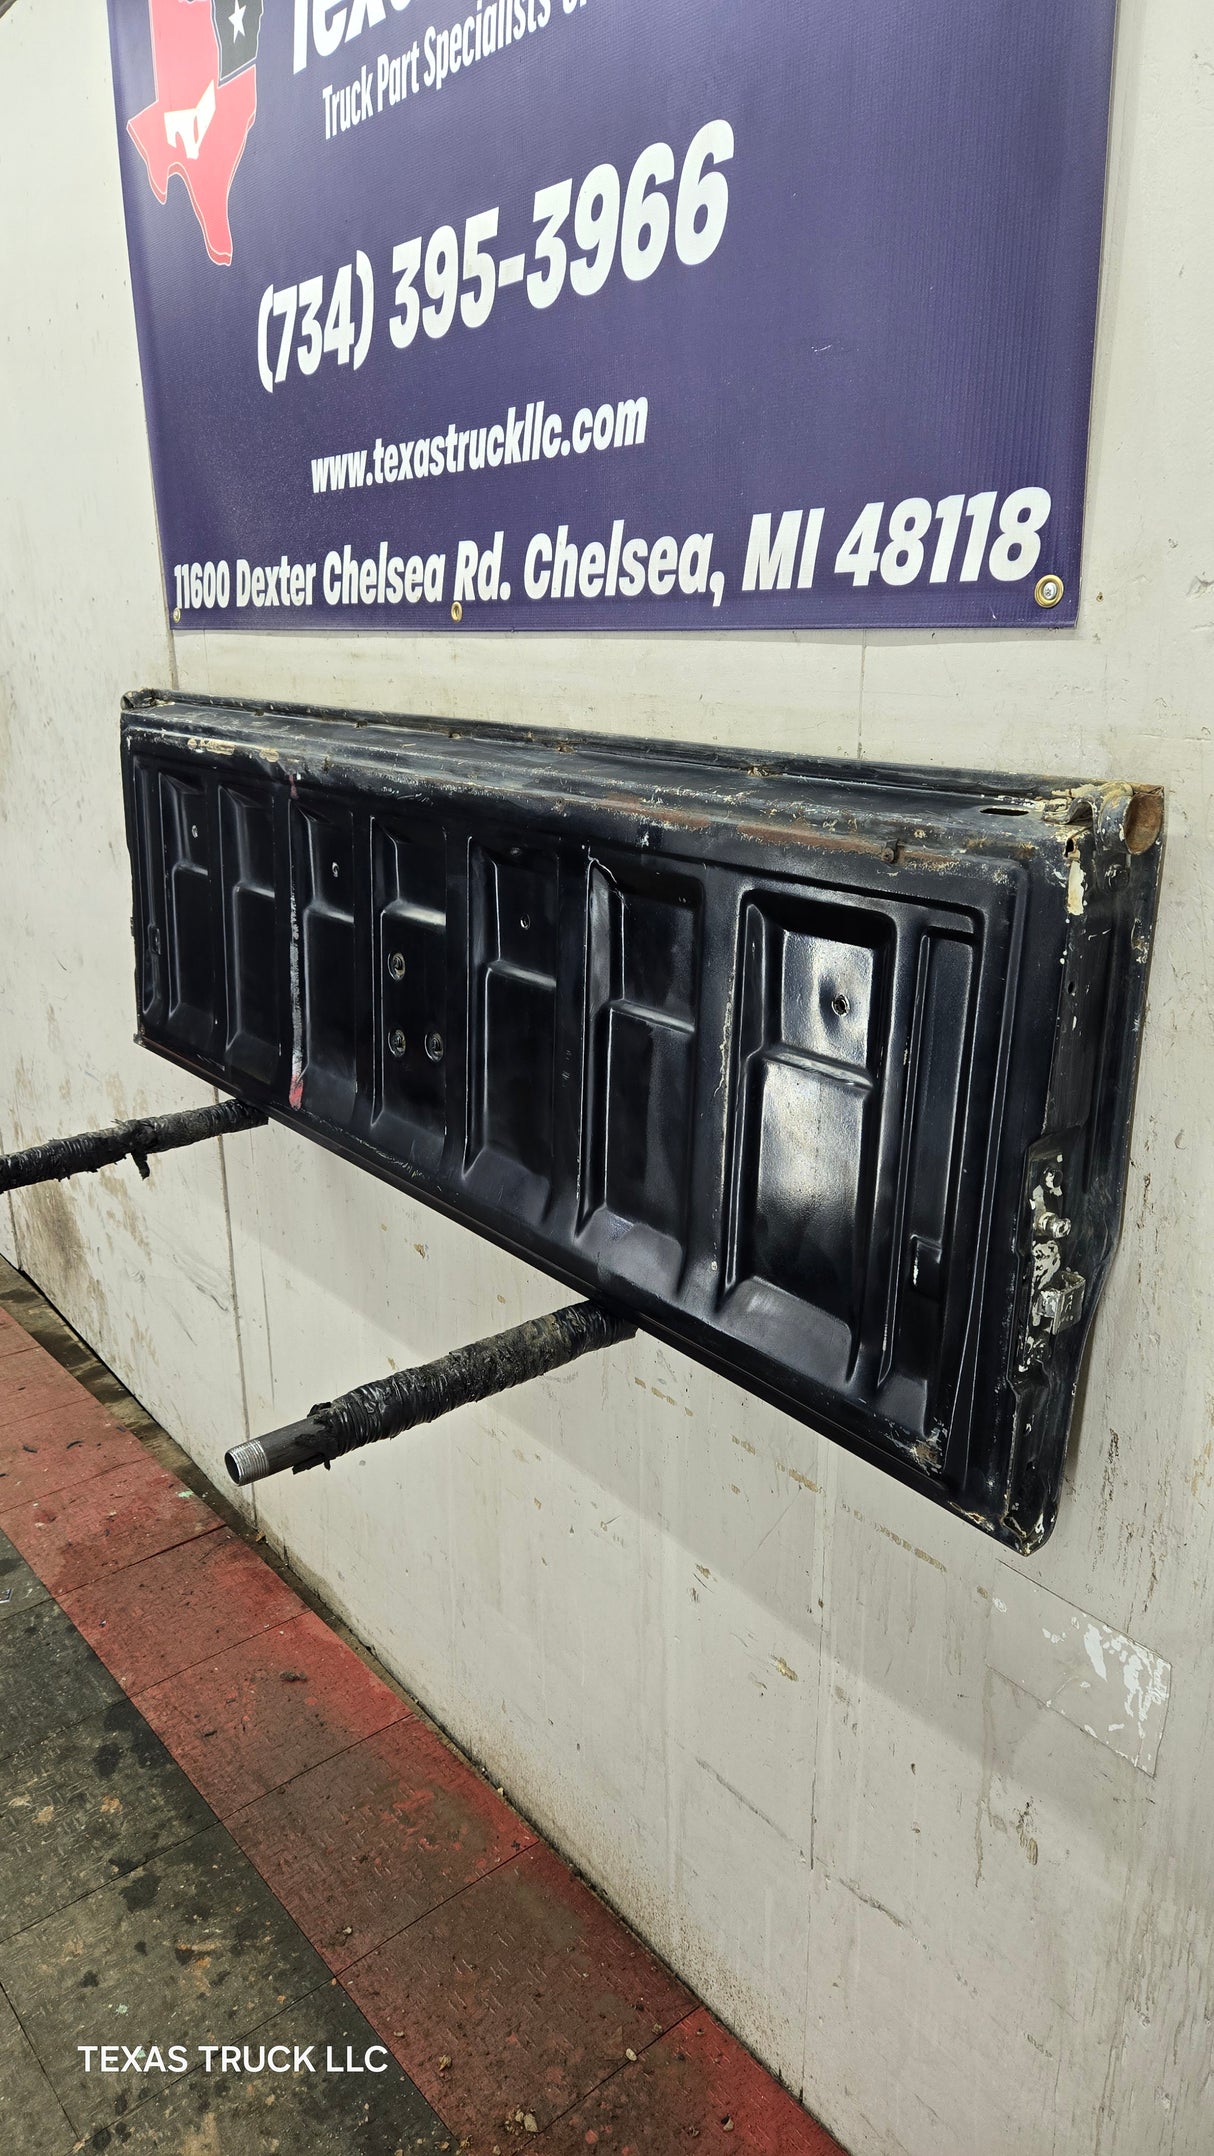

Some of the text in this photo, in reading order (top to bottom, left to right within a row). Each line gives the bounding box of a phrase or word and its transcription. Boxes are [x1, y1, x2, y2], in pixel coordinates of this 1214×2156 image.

[322, 65, 374, 140] Truck
[377, 41, 420, 112] Part
[257, 118, 735, 393] (734) 395-3966
[310, 396, 649, 494] www.texastruckllc.com
[173, 486, 1052, 610] 11600 Dexter Chelsea Rd. Chelsea, MI 48118
